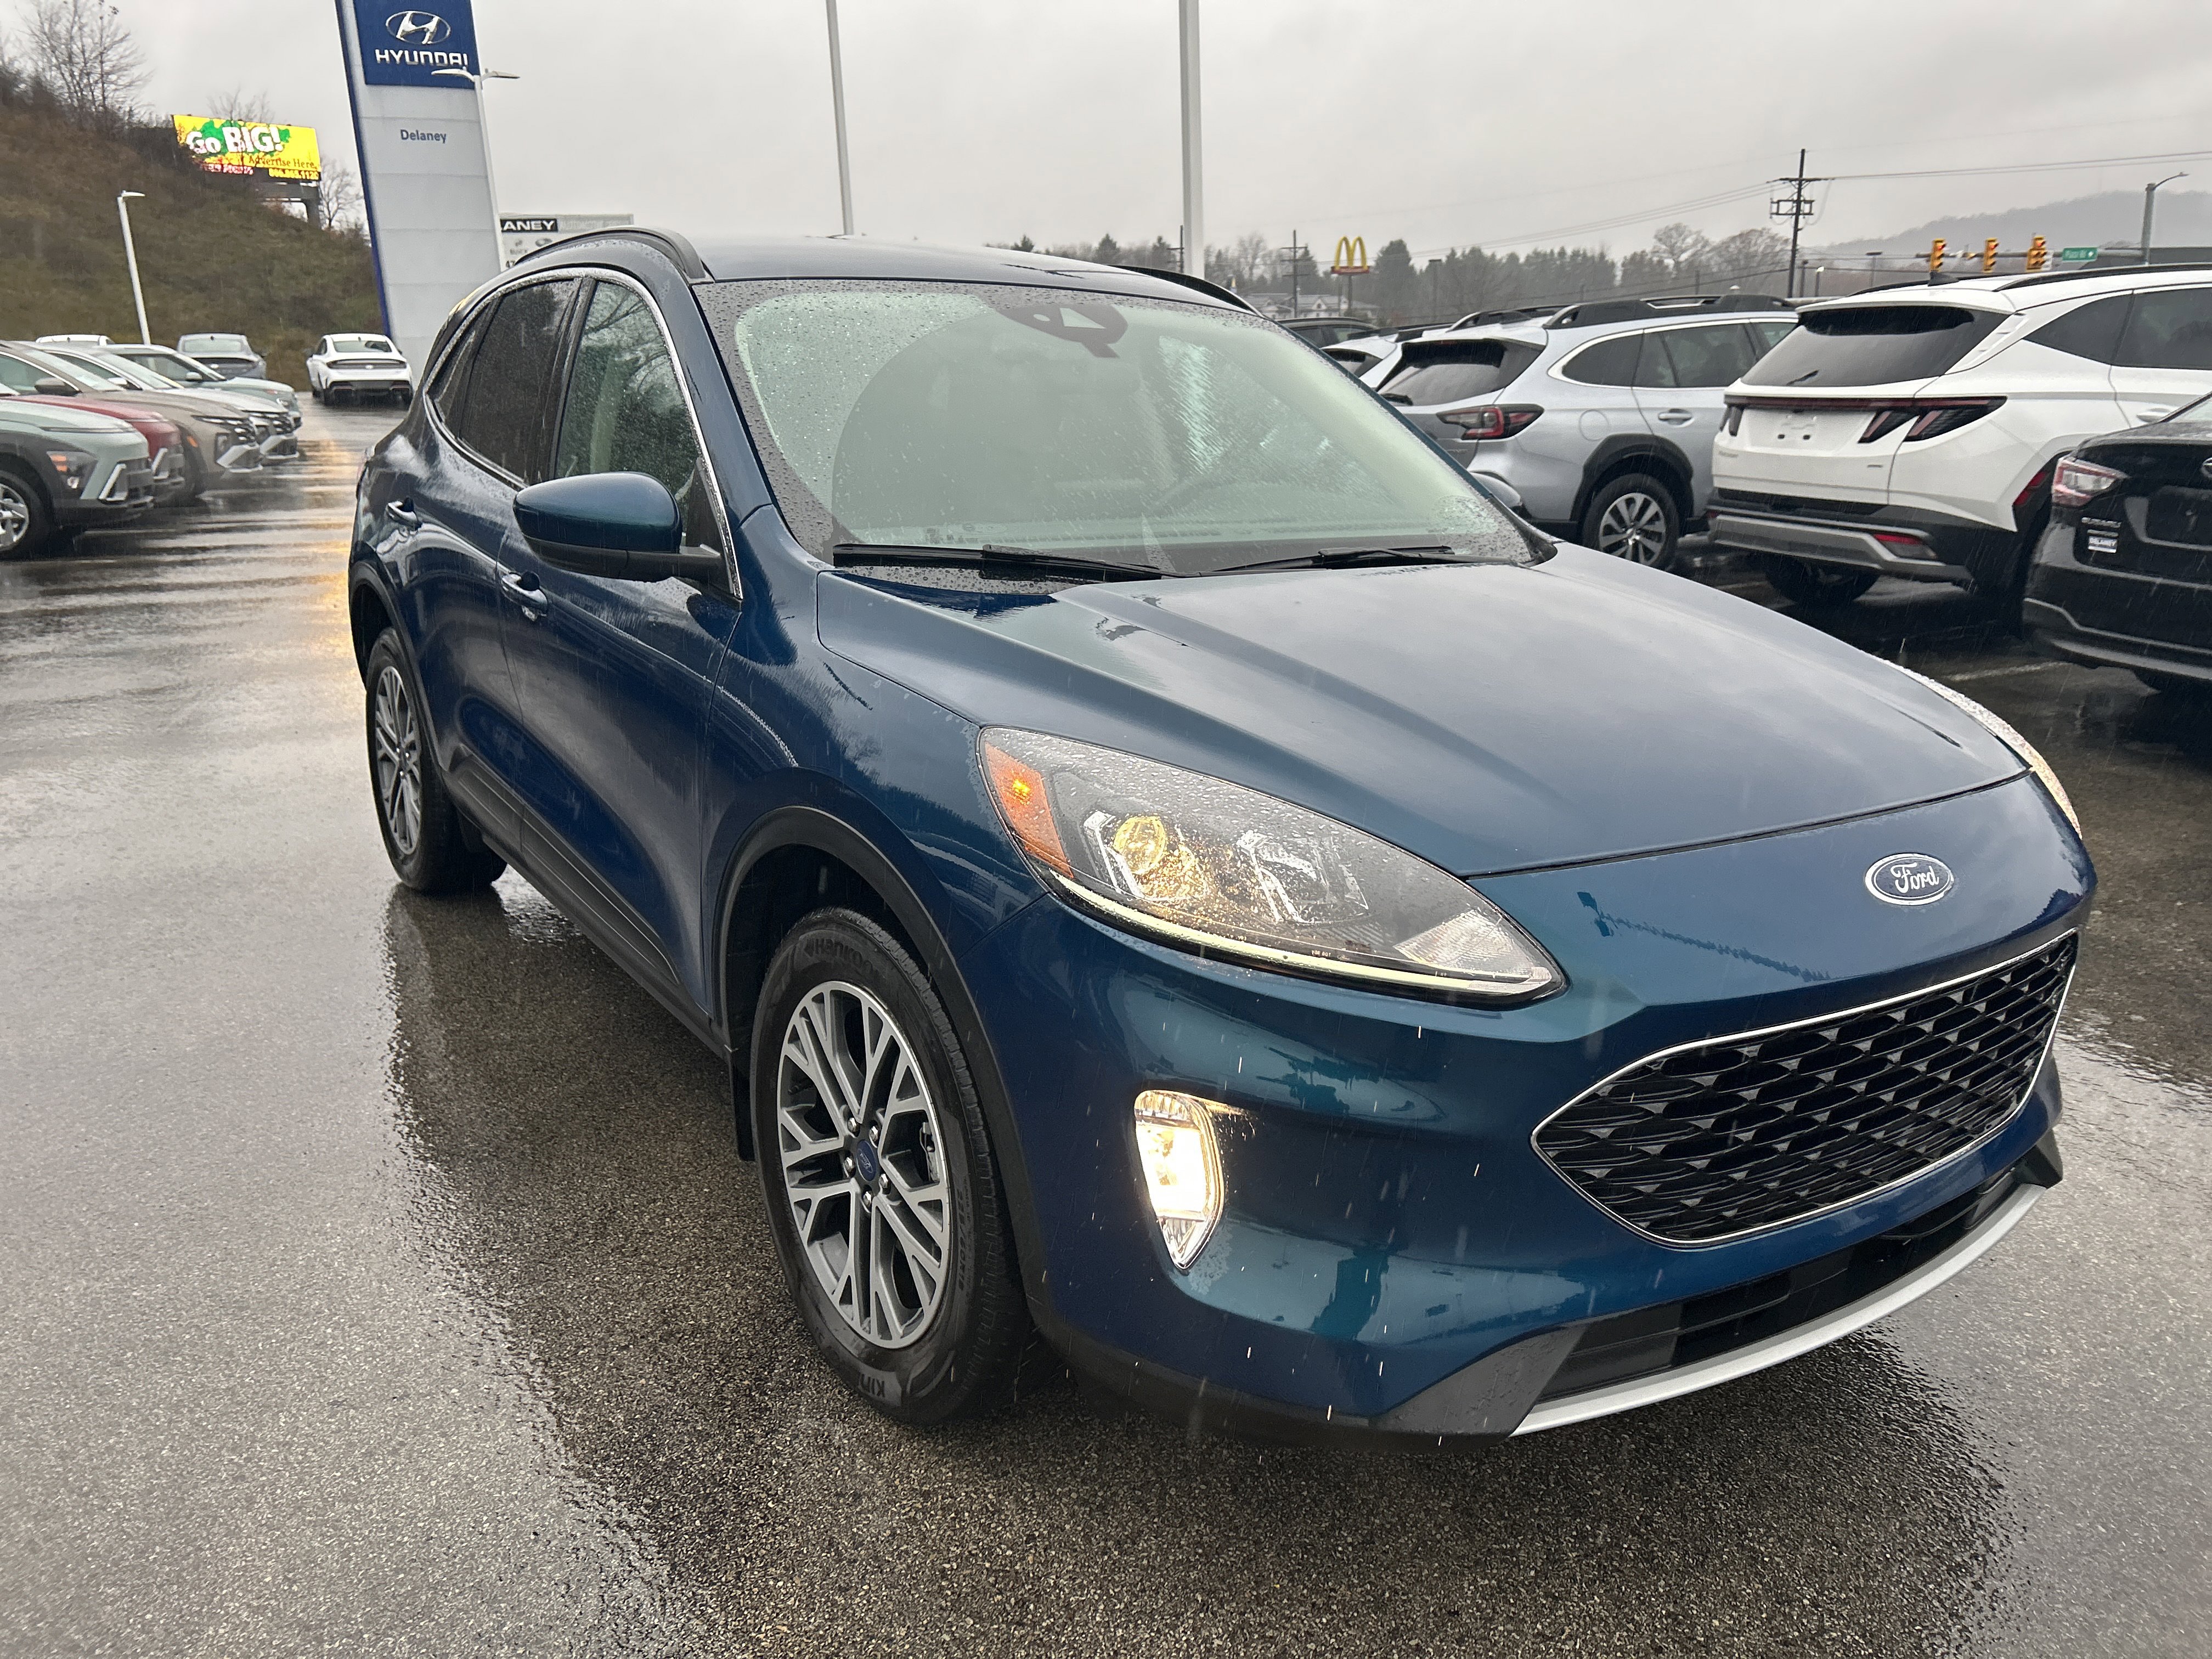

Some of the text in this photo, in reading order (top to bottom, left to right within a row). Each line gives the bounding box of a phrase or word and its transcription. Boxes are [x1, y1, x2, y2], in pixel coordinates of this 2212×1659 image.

[375, 49, 468, 66] HYUNDAI
[185, 126, 284, 154] Go BIG!
[400, 129, 447, 143] Delaney
[501, 220, 555, 230] ANEY
[1891, 862, 1939, 893] Ford
